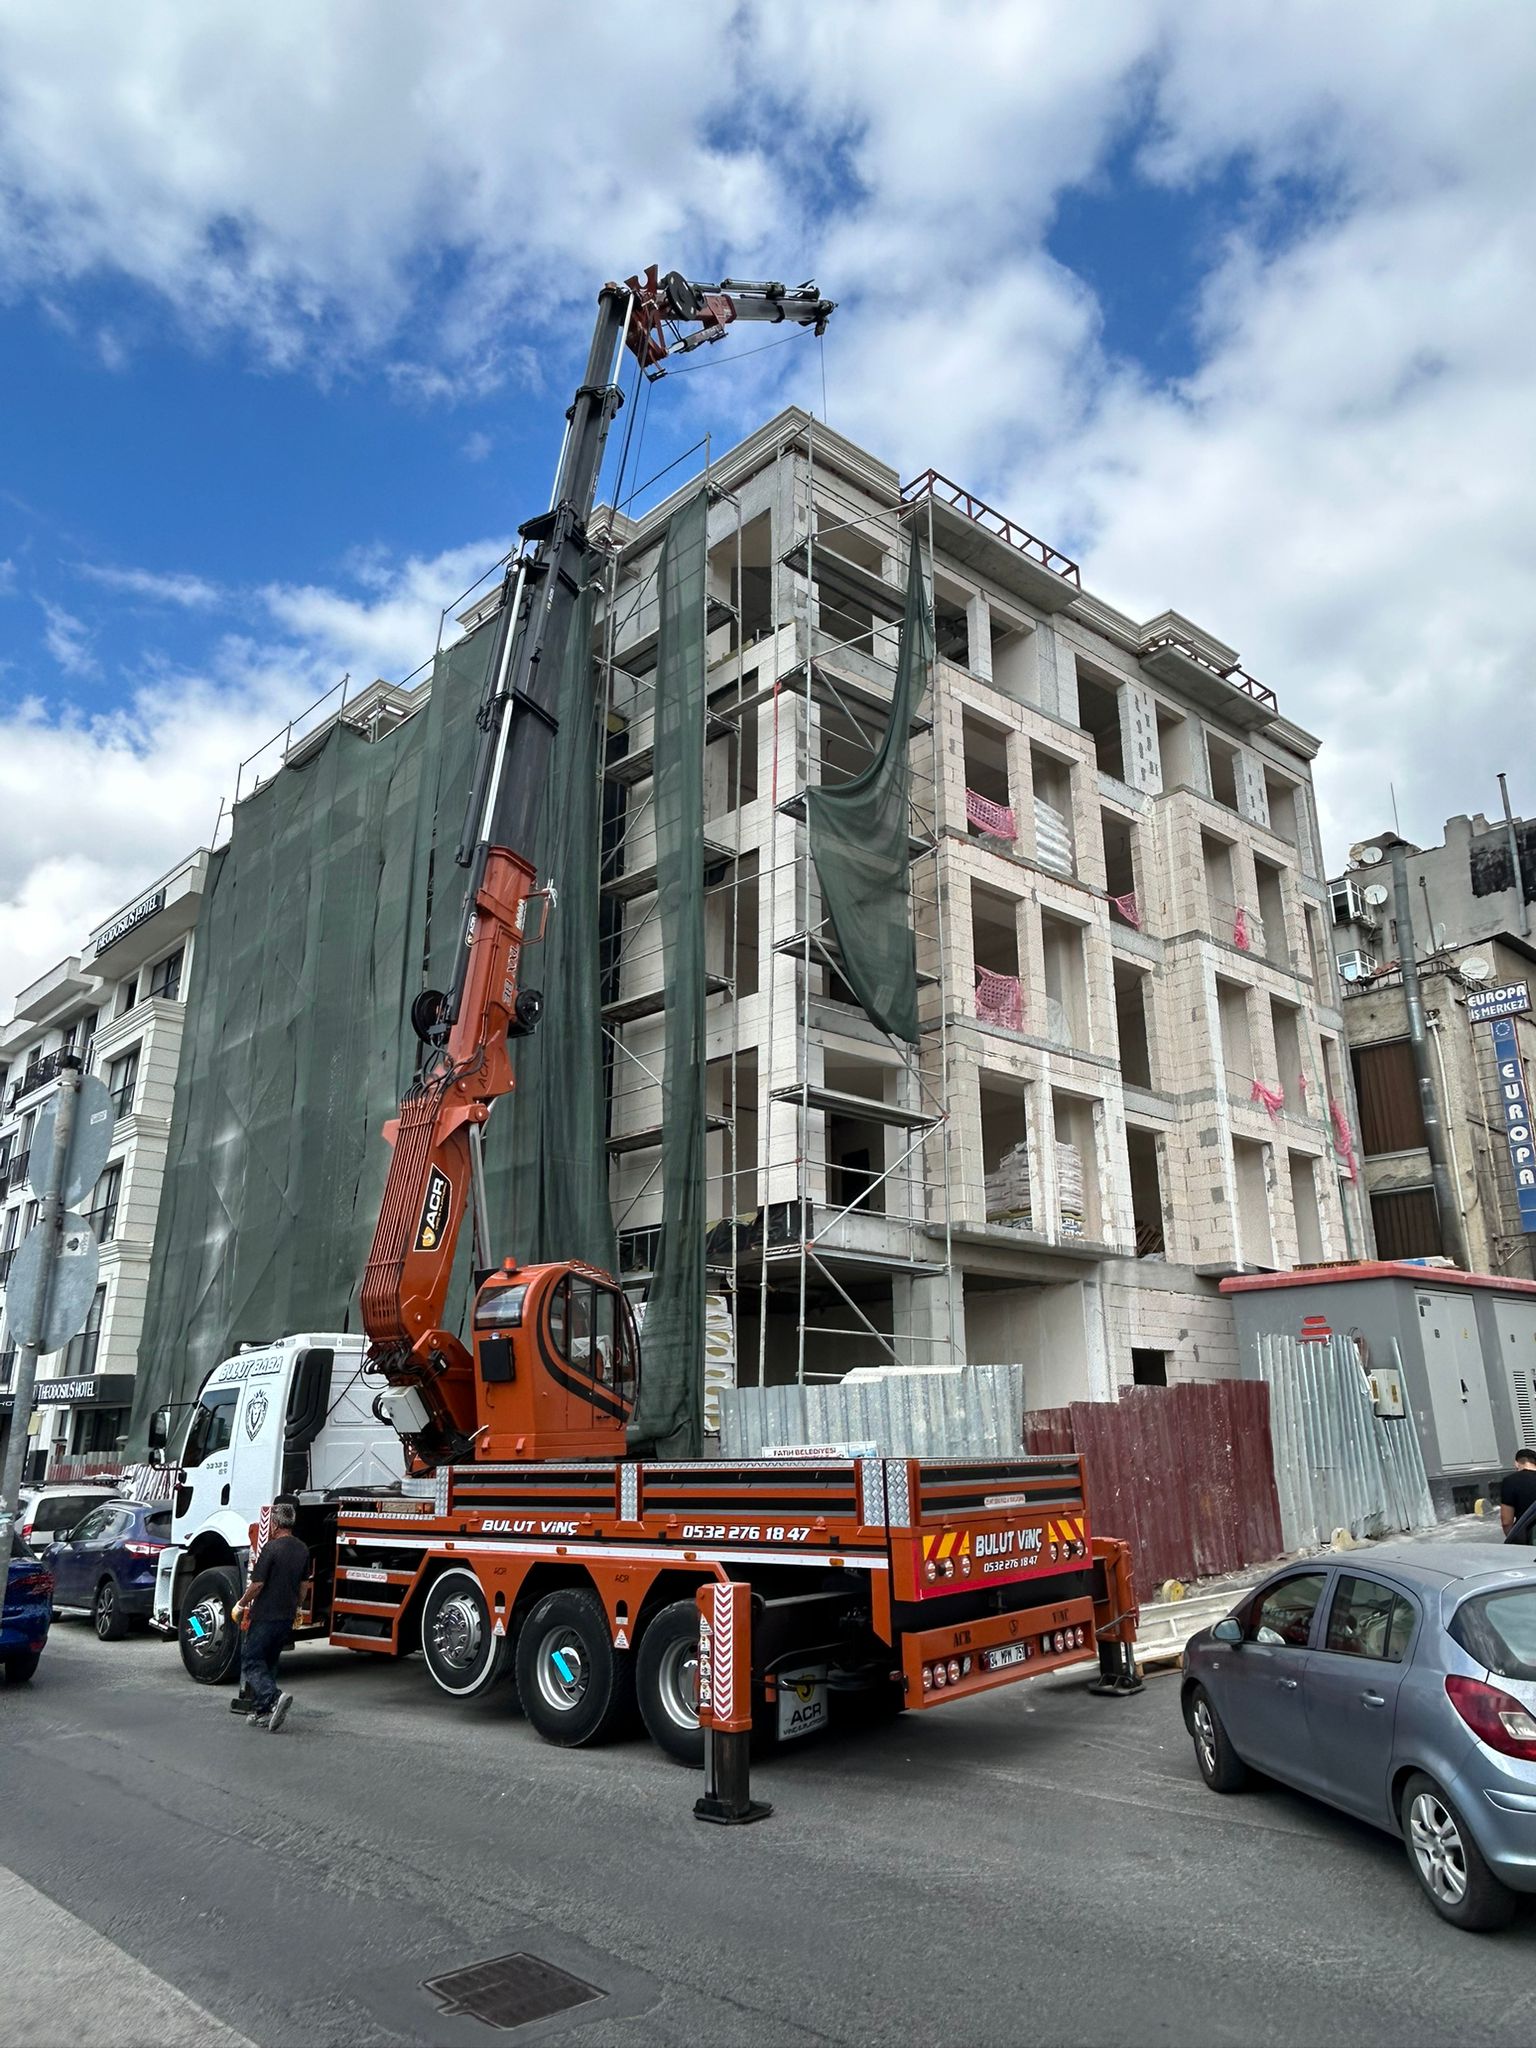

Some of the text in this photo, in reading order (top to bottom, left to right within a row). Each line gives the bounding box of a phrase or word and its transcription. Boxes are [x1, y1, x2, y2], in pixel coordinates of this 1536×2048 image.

[1467, 985, 1527, 1007] EUROPA
[1502, 1063, 1535, 1186] EUROPA
[426, 1177, 444, 1230] ACR
[219, 1356, 283, 1382] BULUT BABA
[37, 1381, 95, 1400] THEODOSIUS HOTEL
[481, 1519, 536, 1533] BULUT
[682, 1525, 811, 1542] 0532 276 18 47
[975, 1531, 1014, 1557] BULUT
[984, 1555, 1038, 1573] 0532 276 18 47
[791, 1703, 822, 1726] ACR
